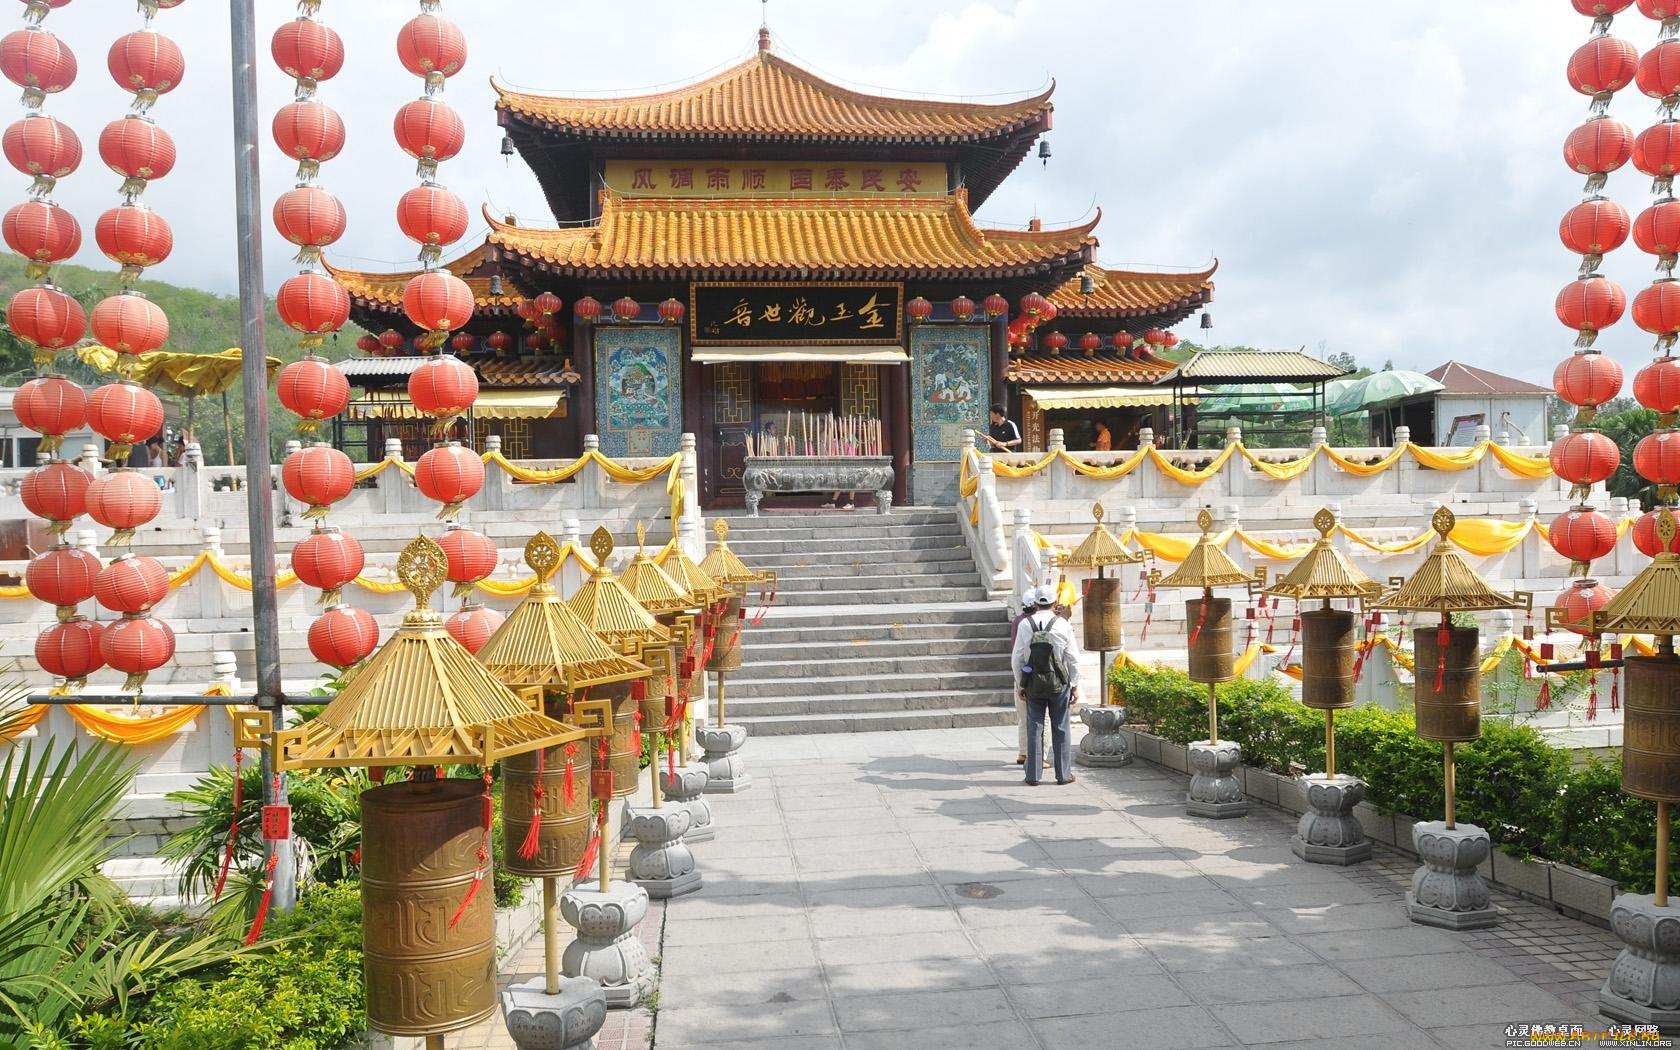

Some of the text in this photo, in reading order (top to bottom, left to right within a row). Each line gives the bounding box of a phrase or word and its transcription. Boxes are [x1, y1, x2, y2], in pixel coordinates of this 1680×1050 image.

[631, 167, 922, 192] 风调雨顺 国泰民安
